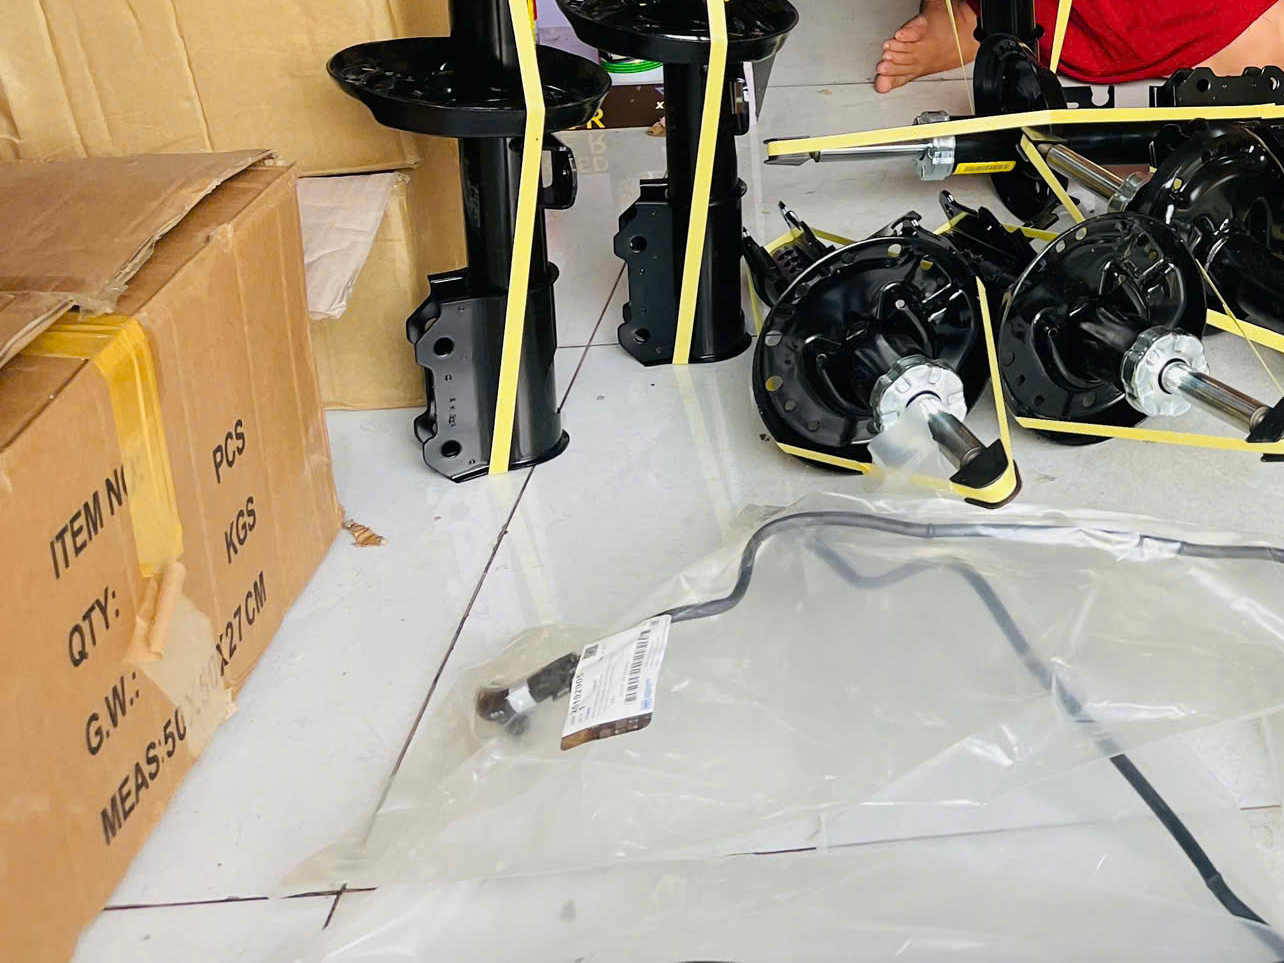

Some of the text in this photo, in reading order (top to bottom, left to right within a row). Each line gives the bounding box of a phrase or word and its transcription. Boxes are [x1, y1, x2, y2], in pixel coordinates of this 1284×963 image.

[212, 418, 247, 484] PCS
[49, 490, 104, 579] ITEM
[224, 496, 257, 565] KGS
[68, 586, 120, 668] QTY:
